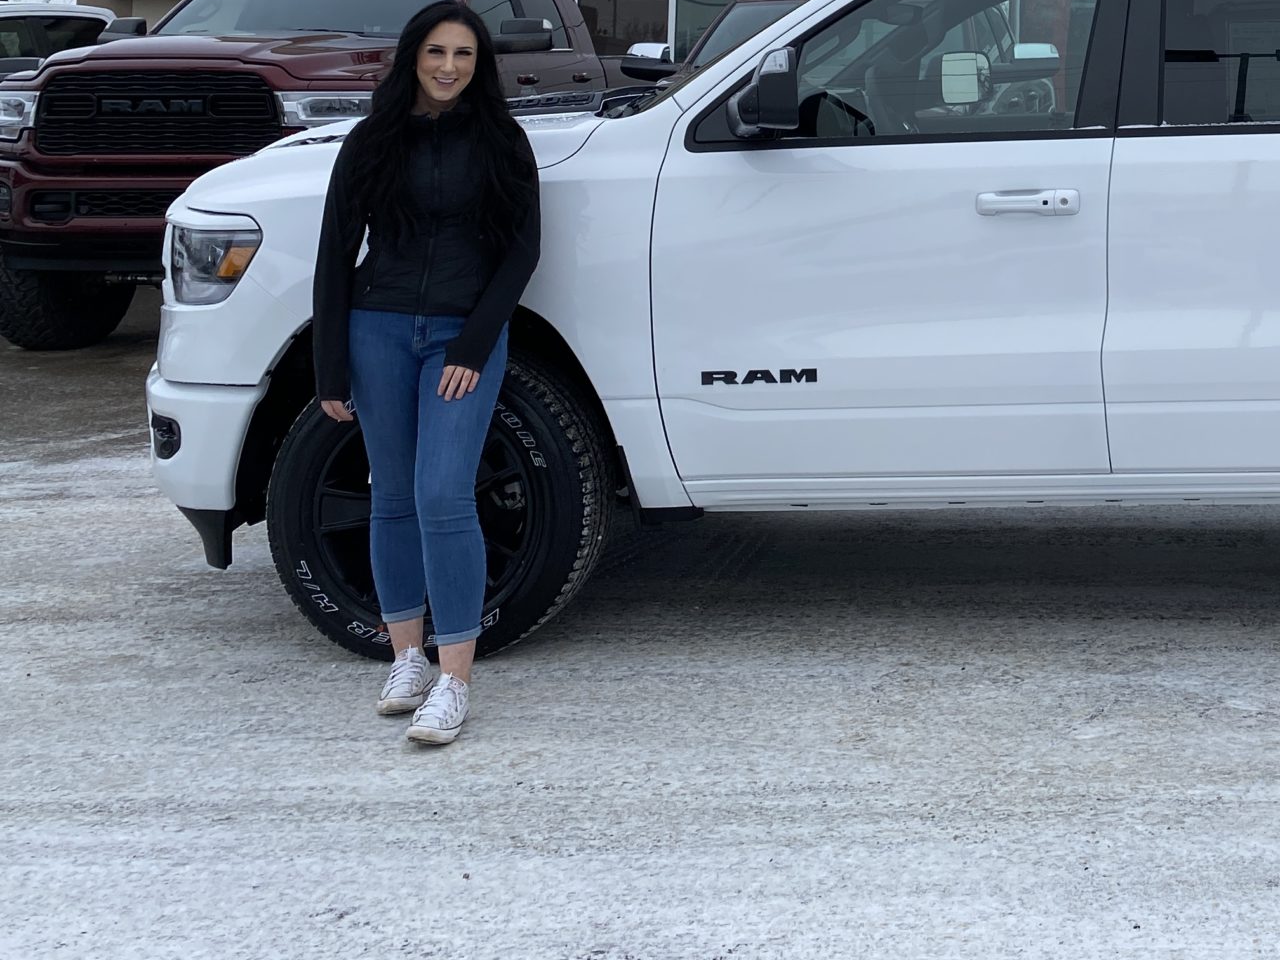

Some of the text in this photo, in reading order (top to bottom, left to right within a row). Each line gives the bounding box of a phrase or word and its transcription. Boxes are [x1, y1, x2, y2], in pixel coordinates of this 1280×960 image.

[101, 99, 204, 113] RAM
[700, 367, 818, 386] RAM
[296, 559, 339, 613] H/L
